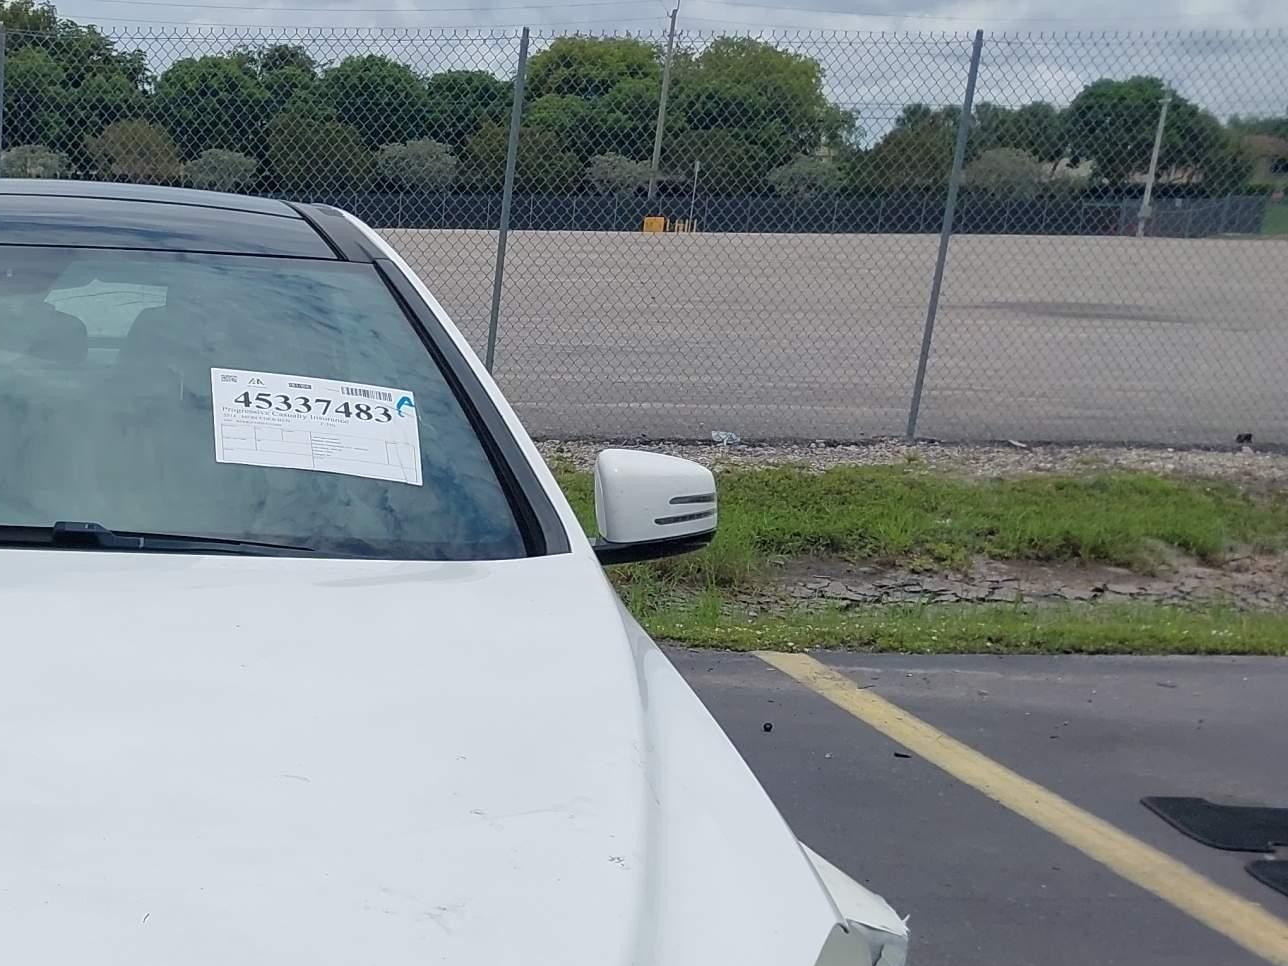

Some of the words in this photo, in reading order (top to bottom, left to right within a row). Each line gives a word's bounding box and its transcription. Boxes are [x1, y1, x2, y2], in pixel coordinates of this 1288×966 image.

[222, 405, 271, 417] Progressive
[271, 409, 308, 421] Casualty
[310, 413, 350, 425] Insurance
[234, 390, 393, 423] 45337483
